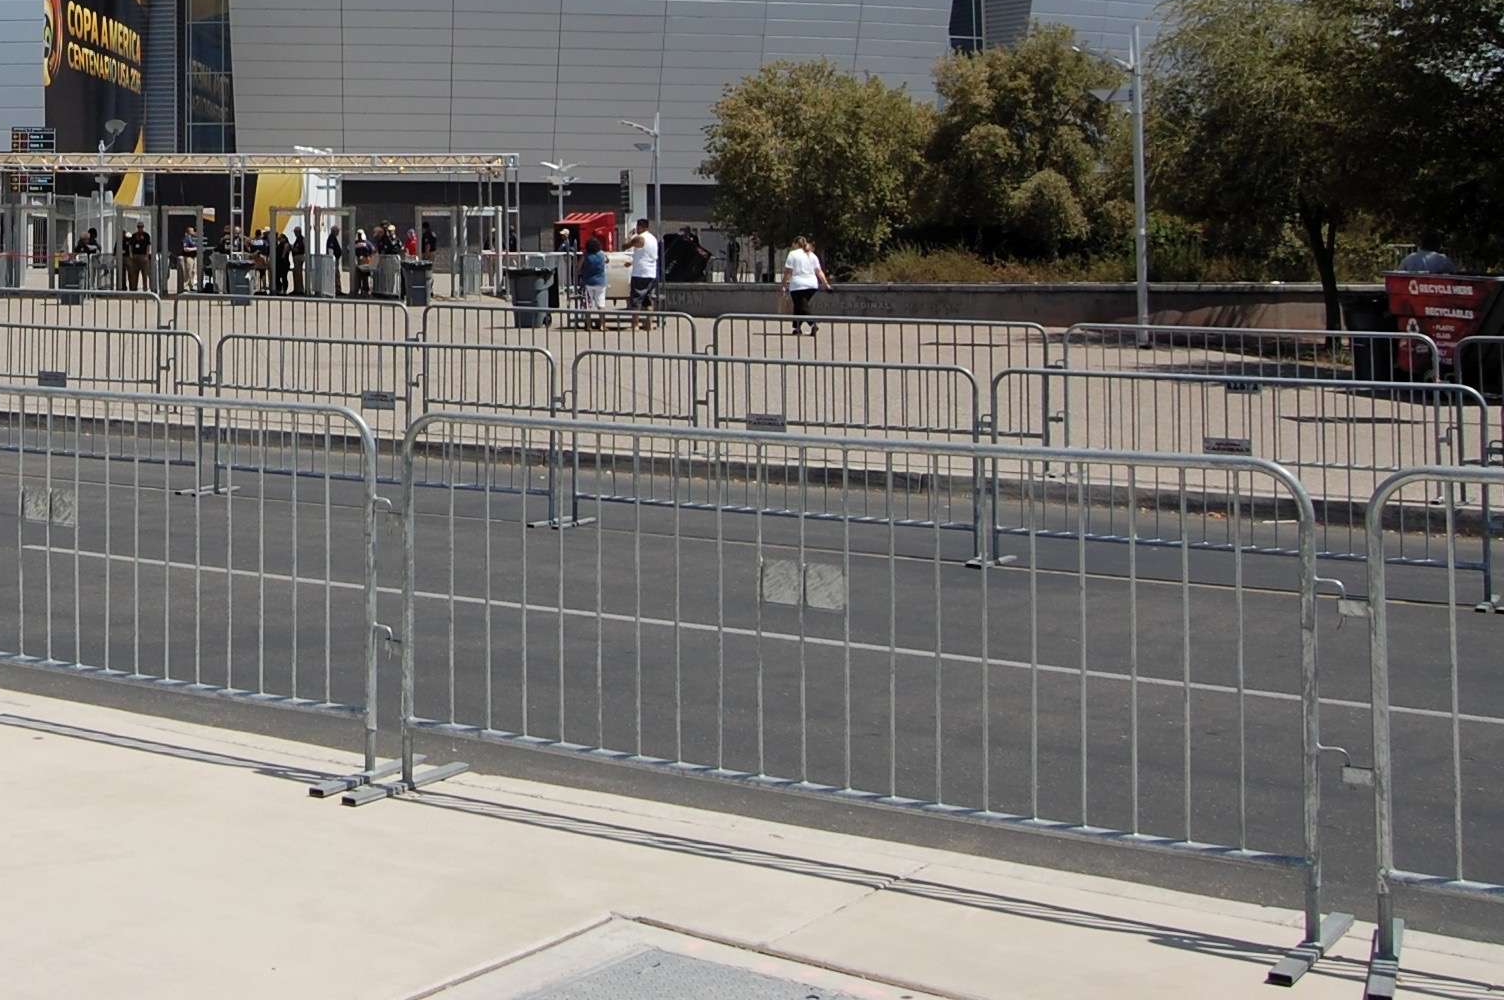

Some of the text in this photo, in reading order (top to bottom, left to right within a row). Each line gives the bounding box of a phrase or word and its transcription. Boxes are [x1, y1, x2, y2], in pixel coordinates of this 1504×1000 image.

[67, 0, 142, 67] COPA AMERICA
[67, 41, 116, 84] CENTENARIO
[117, 61, 130, 89] USA
[1418, 283, 1452, 295] RECYCLE
[1424, 306, 1475, 319] RECYCLABLES
